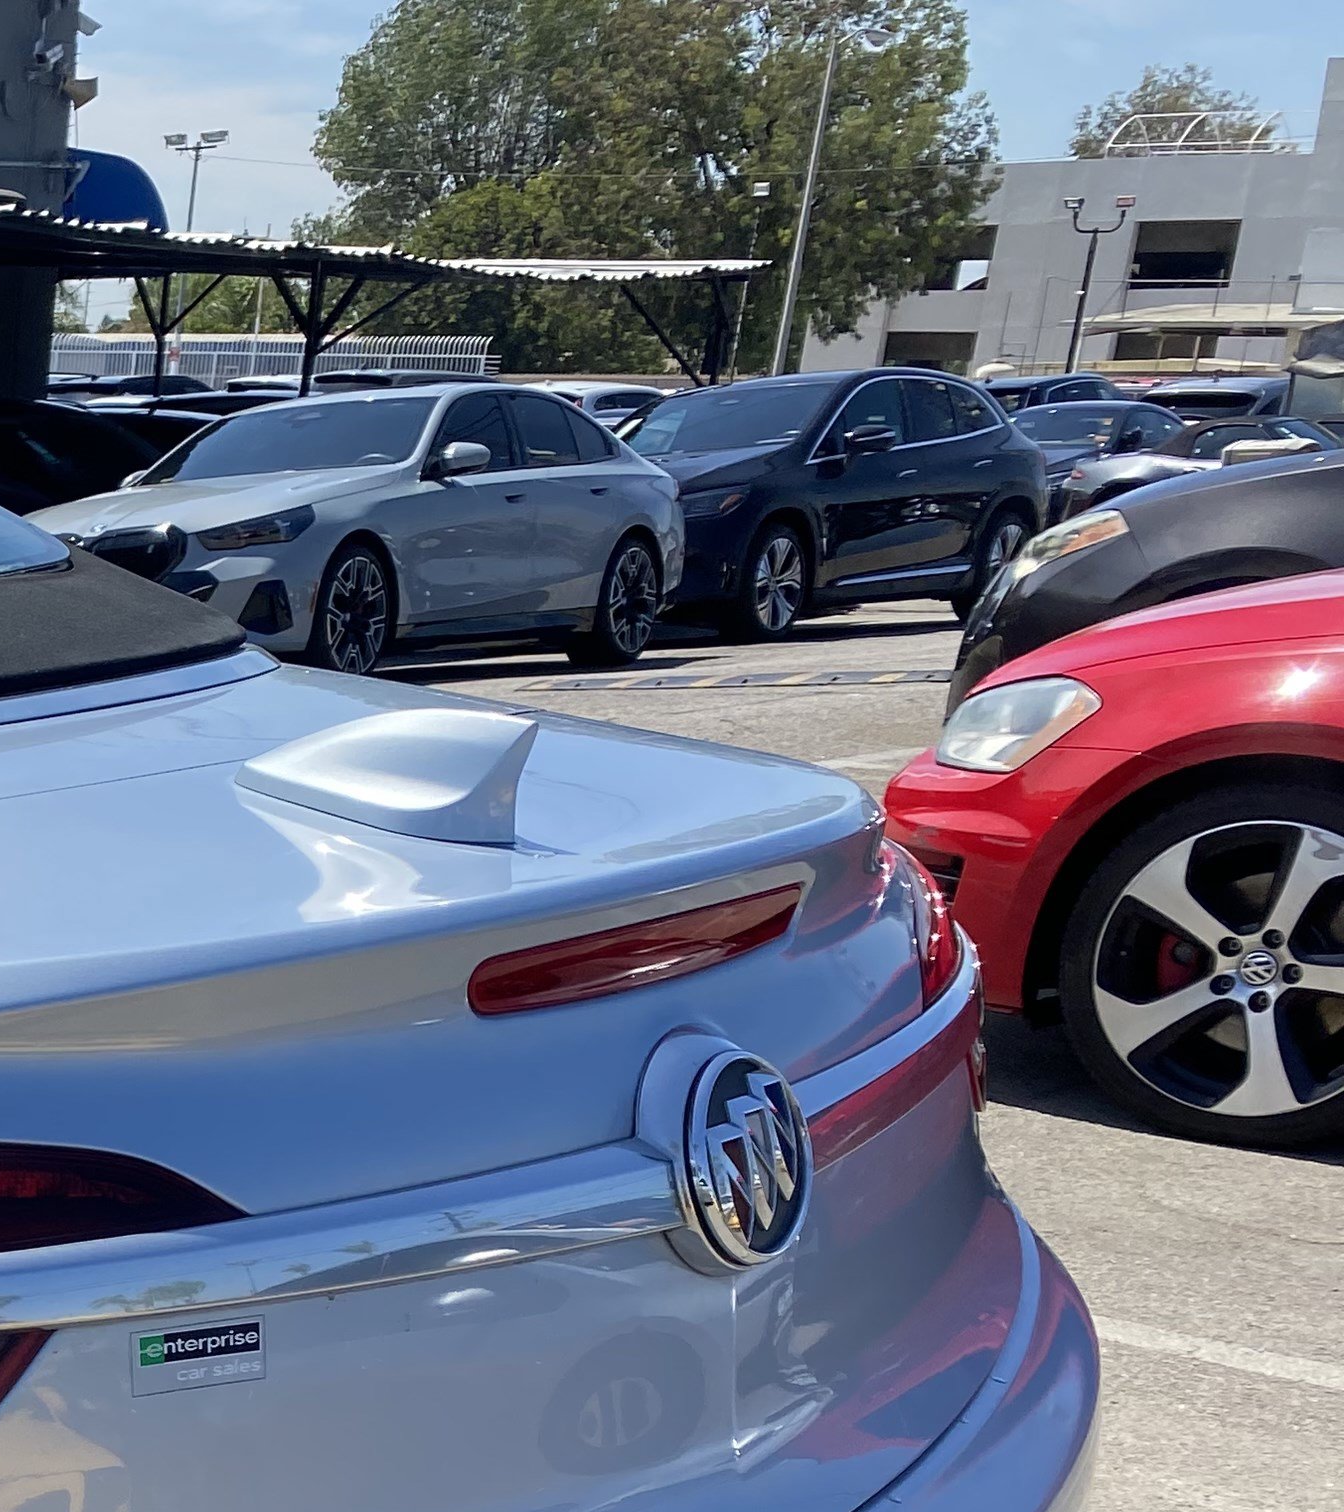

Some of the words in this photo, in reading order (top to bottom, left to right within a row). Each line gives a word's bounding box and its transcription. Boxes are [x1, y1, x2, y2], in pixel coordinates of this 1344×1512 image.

[144, 1329, 259, 1358] enterprise
[176, 1365, 209, 1382] car
[213, 1358, 261, 1378] sales
